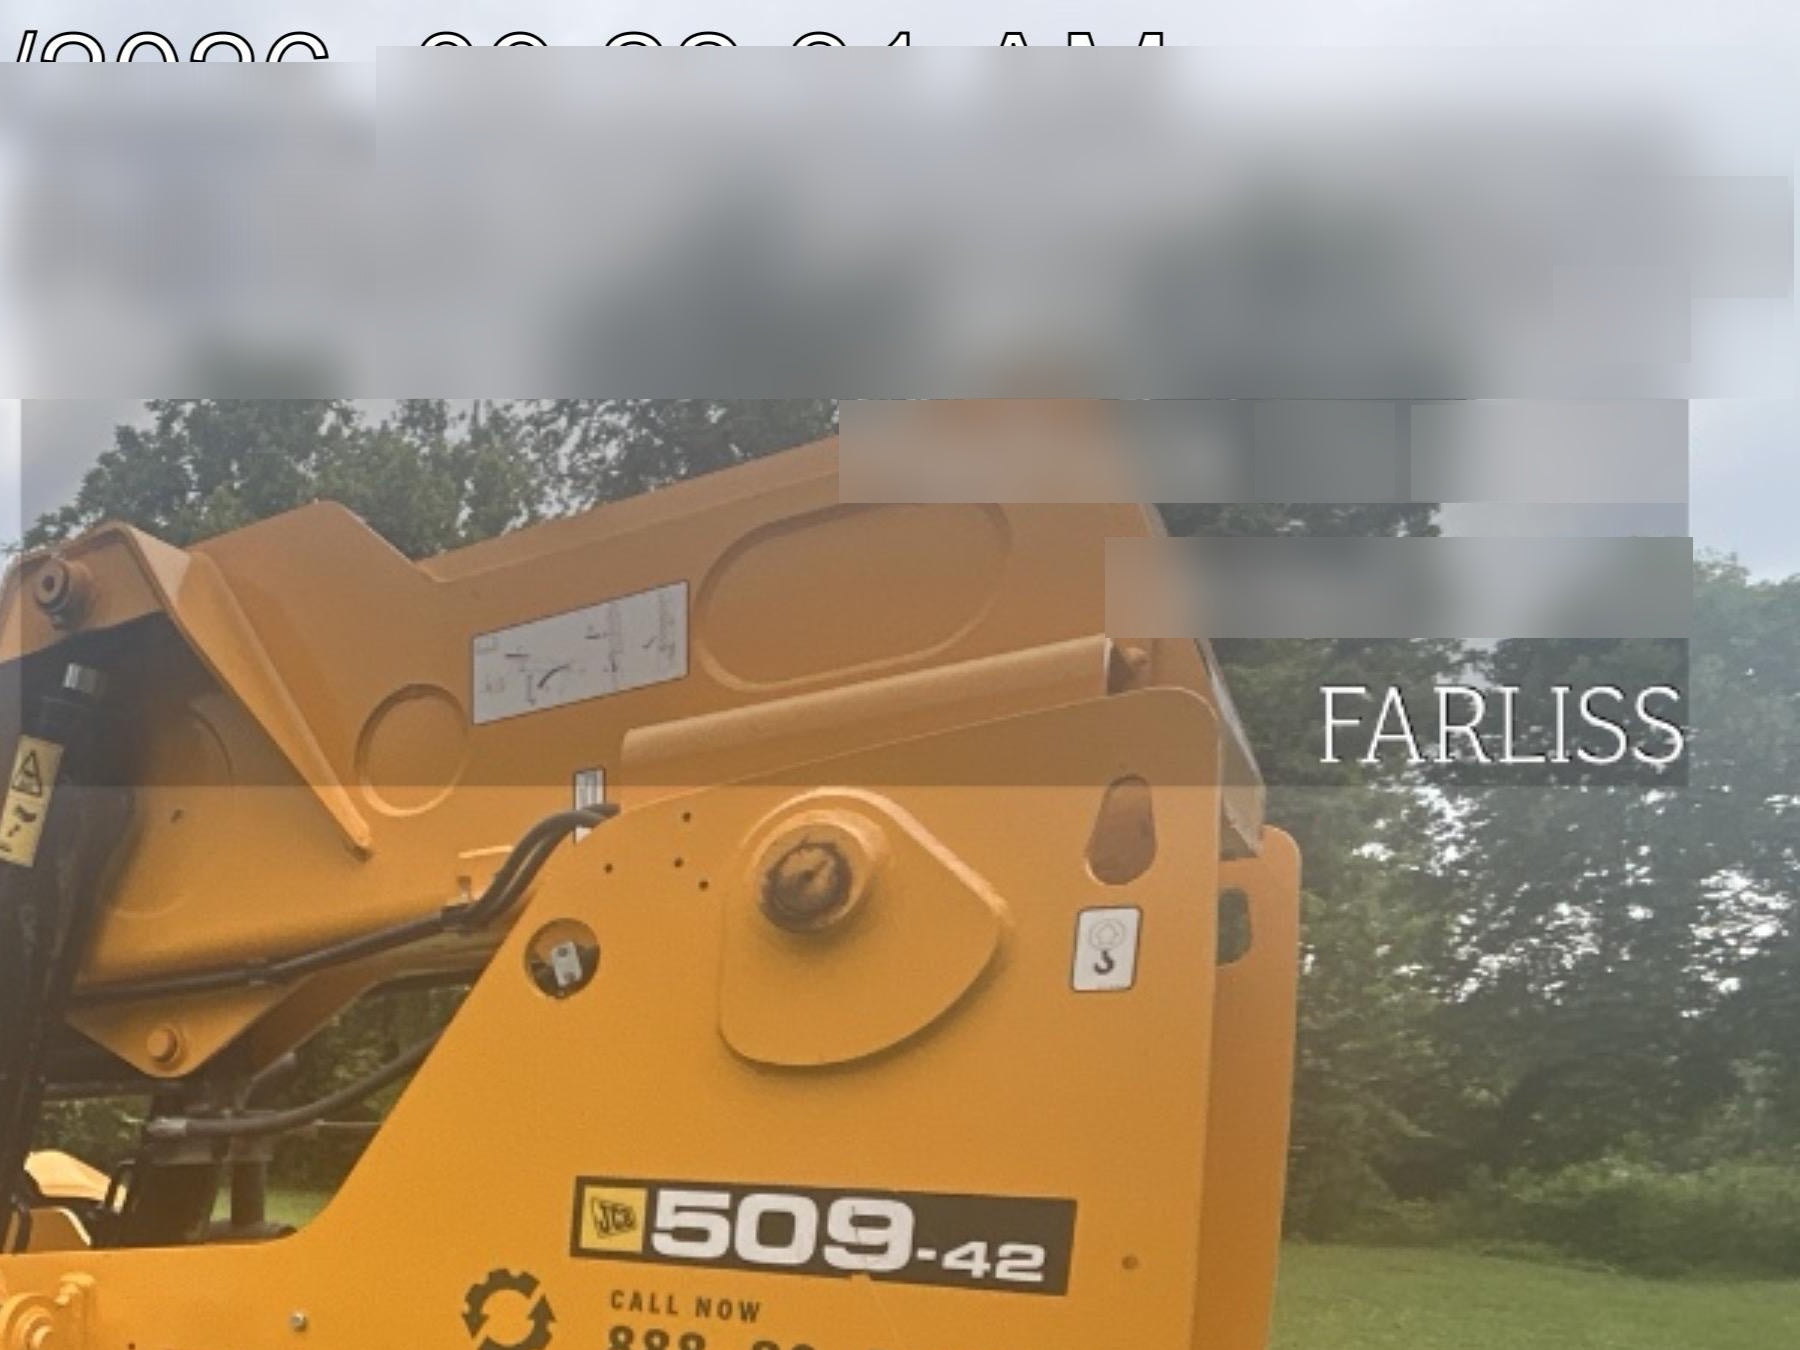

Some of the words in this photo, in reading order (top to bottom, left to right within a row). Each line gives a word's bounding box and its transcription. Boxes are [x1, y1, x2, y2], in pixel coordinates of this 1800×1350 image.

[651, 1189, 1046, 1282] 509-42
[610, 1290, 679, 1316] CALL
[695, 1295, 762, 1323] NOW
